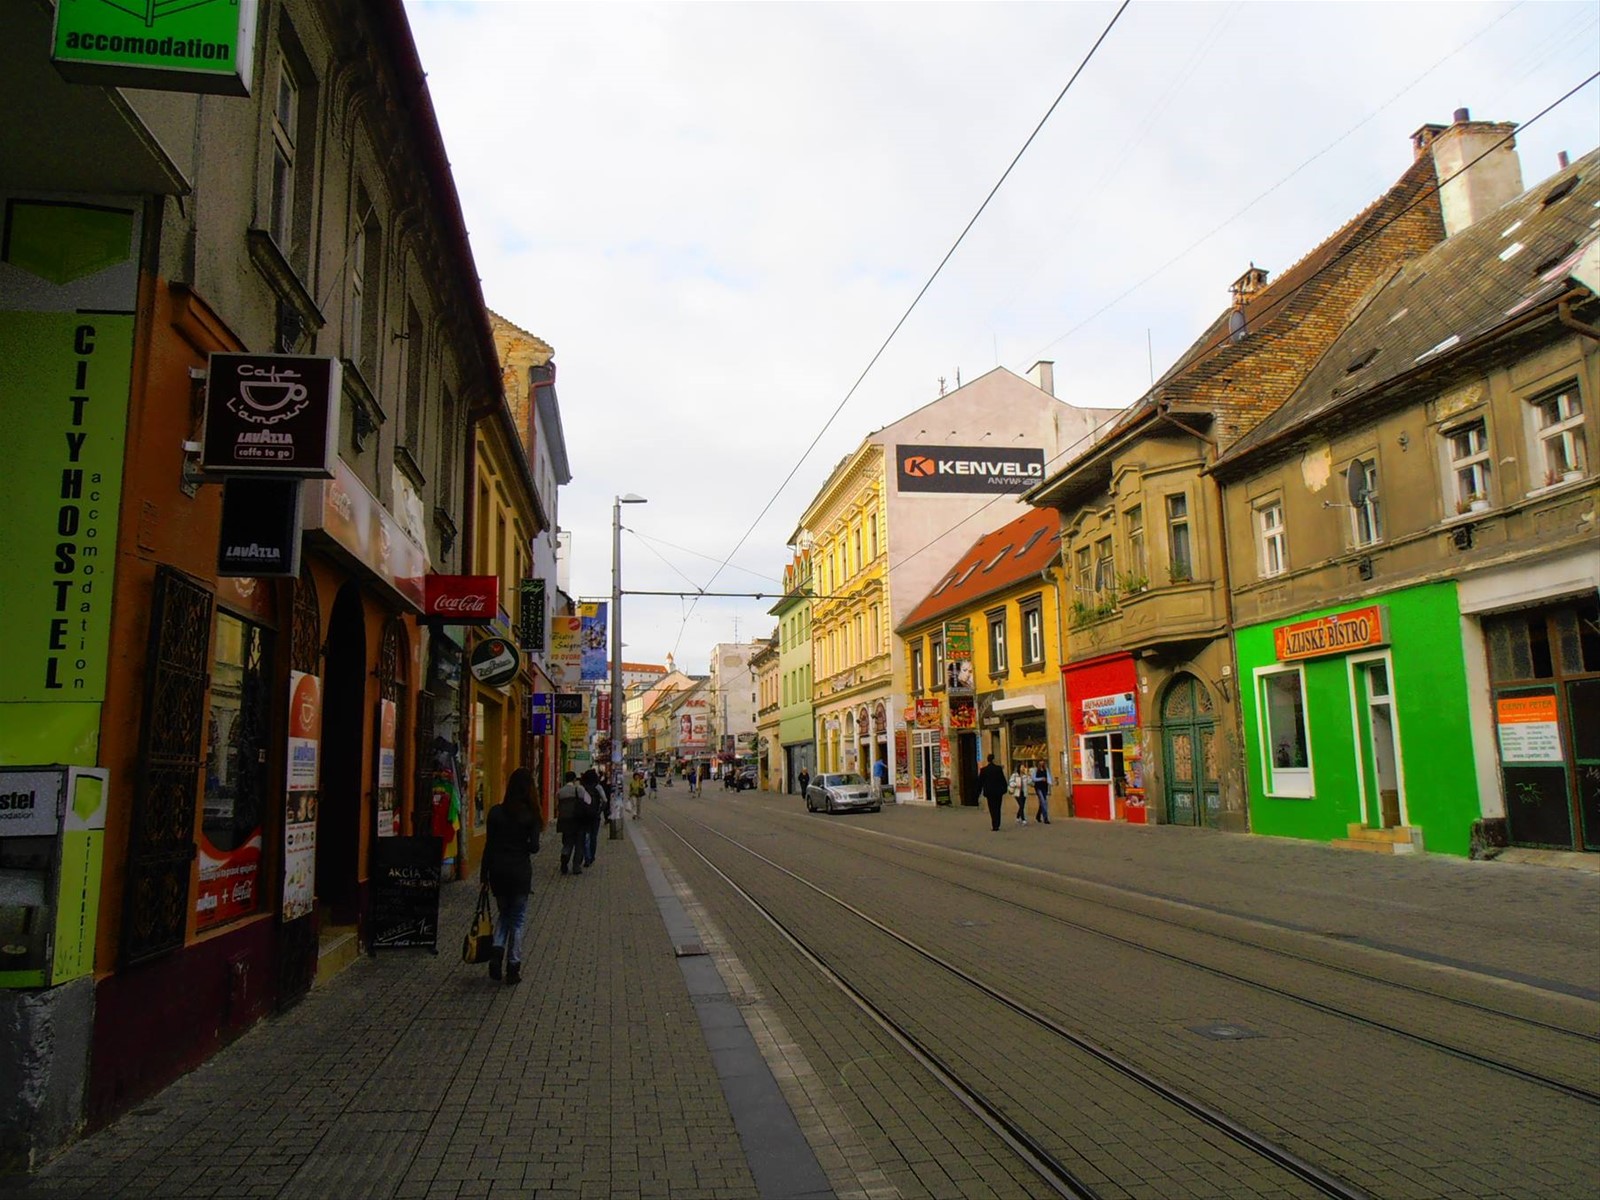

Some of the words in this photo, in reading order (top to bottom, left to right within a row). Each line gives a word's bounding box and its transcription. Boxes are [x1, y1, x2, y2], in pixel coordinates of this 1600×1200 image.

[65, 30, 230, 61] accomodation
[236, 364, 302, 383] Cafe
[237, 428, 294, 444] LAVAZZA
[239, 447, 262, 457] coffe
[264, 447, 275, 457] to
[277, 449, 290, 459] go
[938, 460, 1042, 477] KENVELO
[45, 324, 96, 690] CITYHOSTEL
[225, 542, 281, 558] LAVAZZA
[73, 472, 101, 690] accomodation
[1328, 618, 1369, 647] BISTRO
[685, 699, 706, 708] KFC
